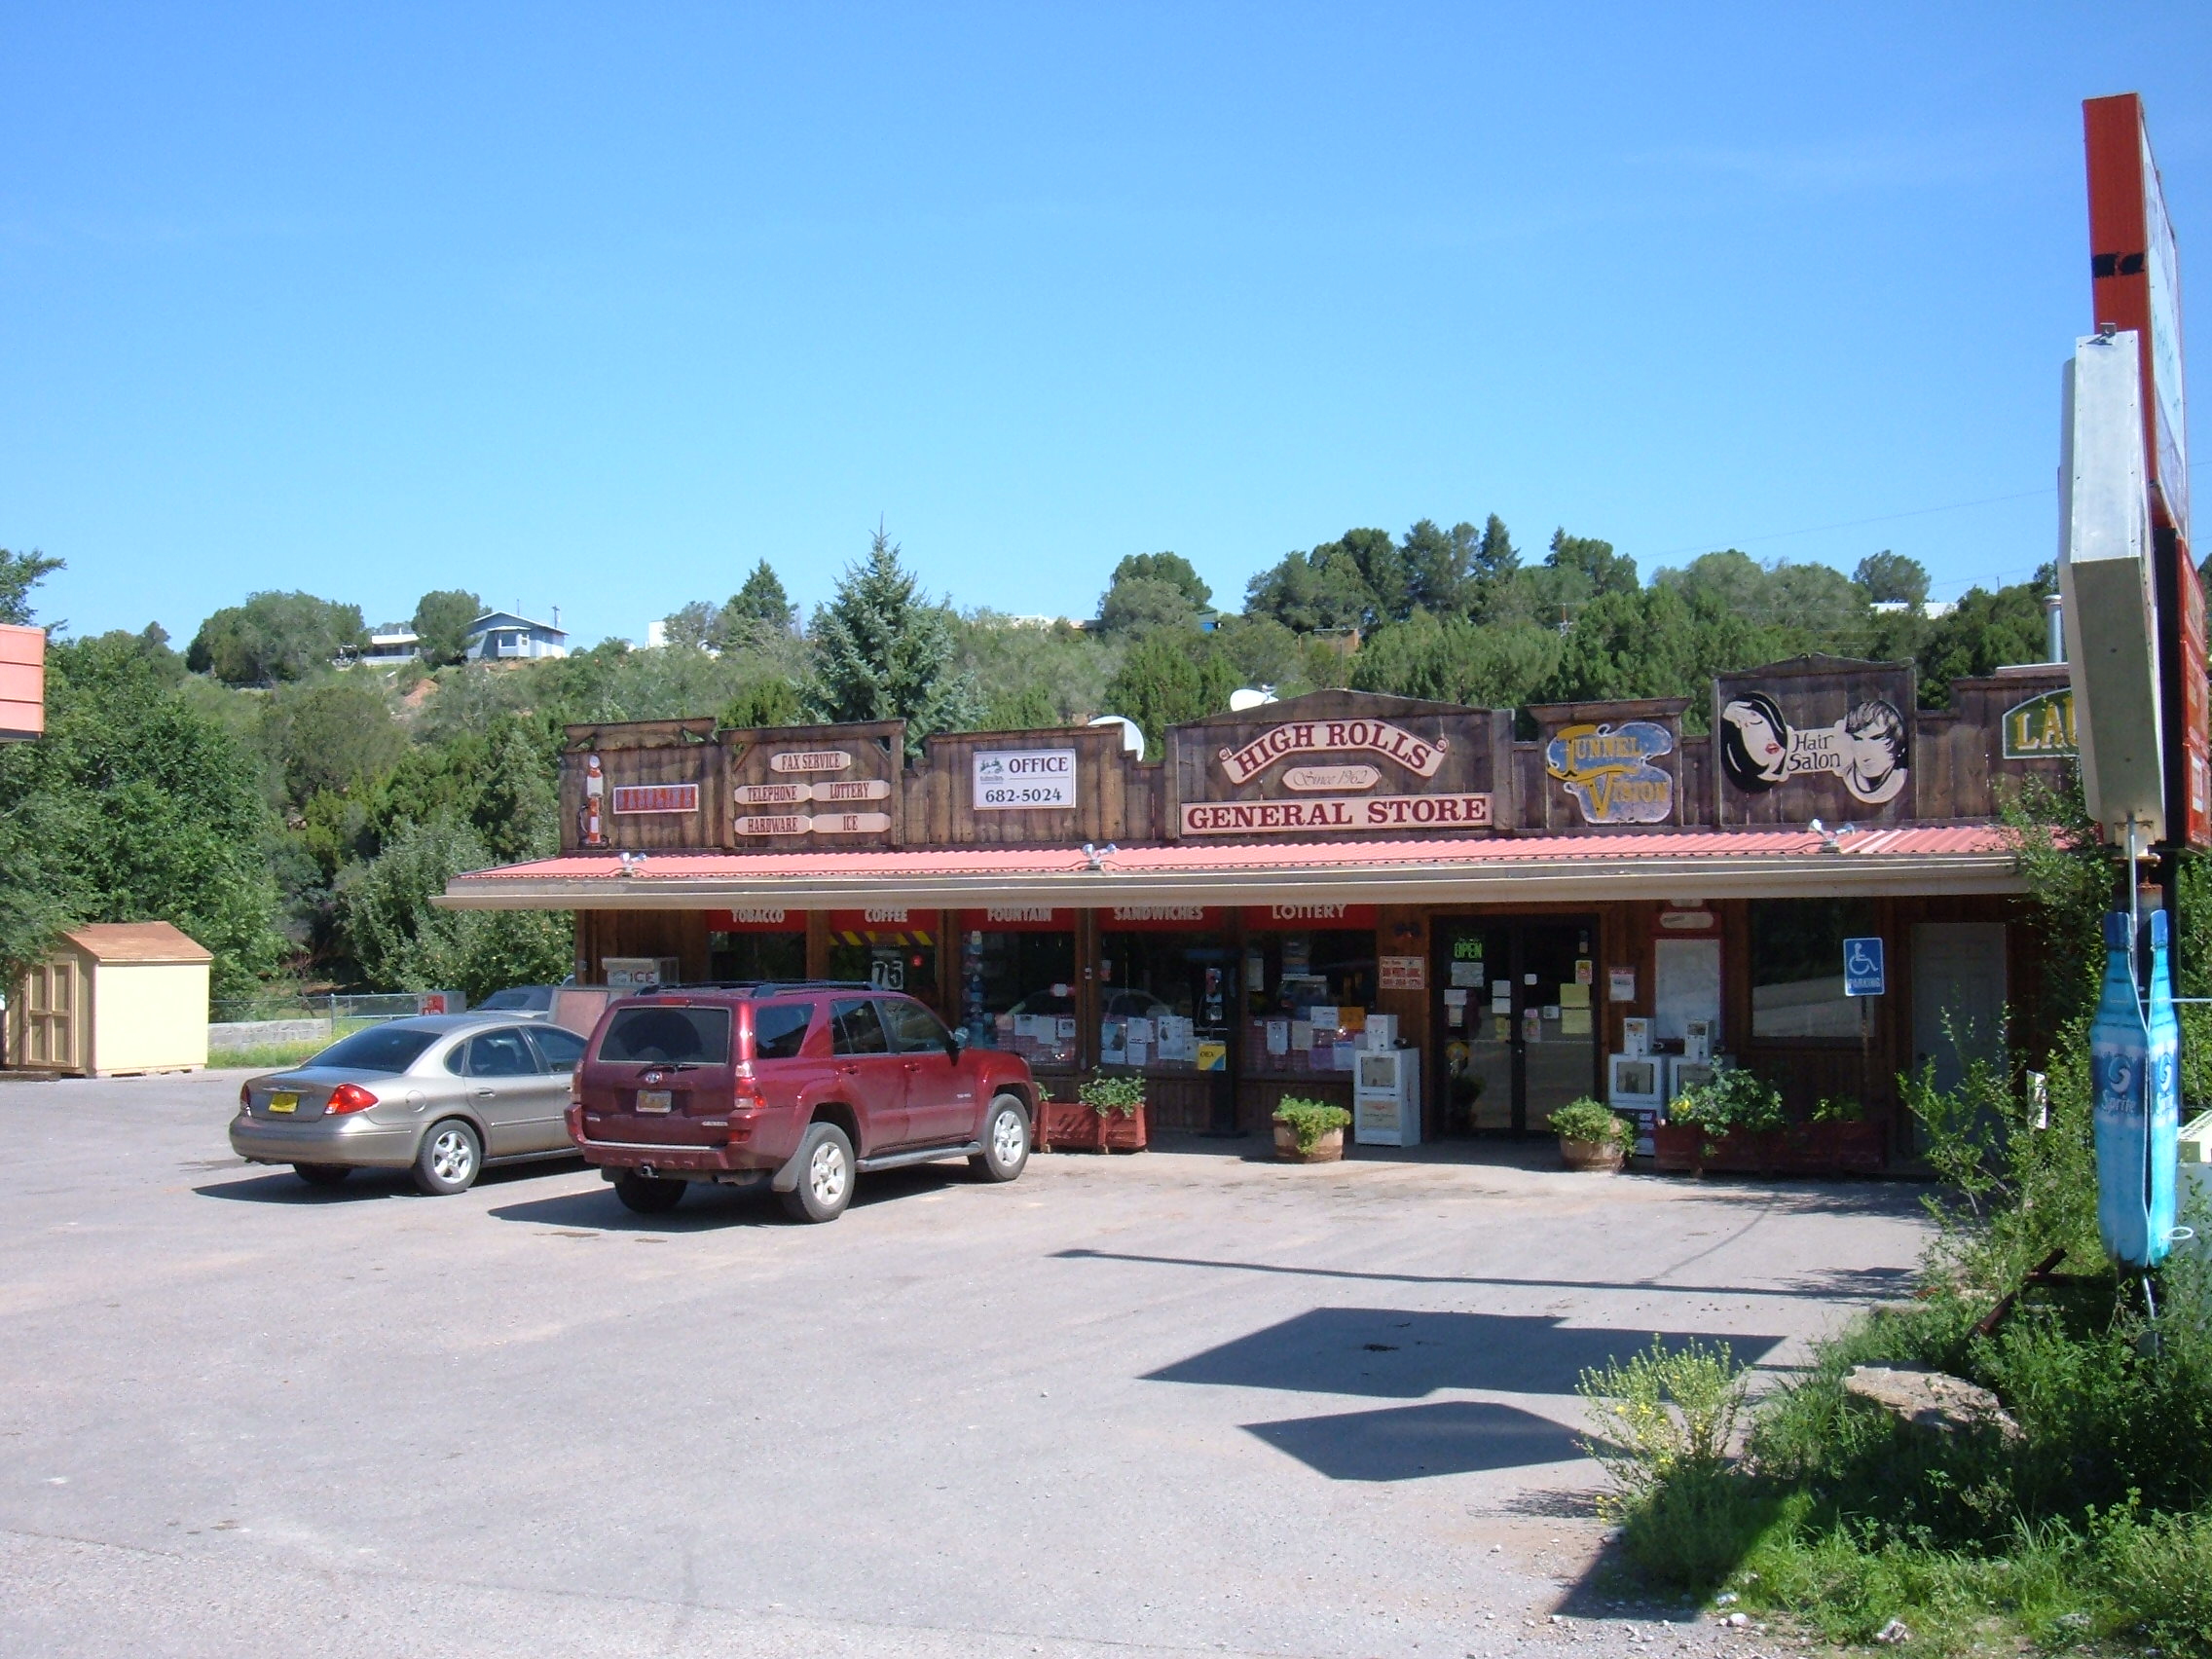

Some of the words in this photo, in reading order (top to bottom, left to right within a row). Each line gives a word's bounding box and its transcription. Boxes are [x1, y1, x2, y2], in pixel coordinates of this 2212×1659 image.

[1234, 723, 1315, 778] HIGH
[1326, 721, 1432, 770] ROLLS
[1554, 723, 1643, 776] TUNNEL
[1791, 732, 1835, 754] Hair
[782, 755, 800, 771] FAX
[802, 752, 841, 769] SERVICE
[1009, 756, 1069, 773] OFFICE
[1787, 752, 1841, 772] Salon
[747, 785, 797, 802] TELEPHONE
[829, 782, 870, 799] LOTTERY
[985, 787, 1063, 803] 682-5024
[1576, 774, 1669, 819] VISION
[1187, 802, 1353, 829] GENERAL
[1367, 797, 1487, 824] STORE
[747, 817, 798, 833] HARDWARE
[842, 815, 858, 831] ICE
[731, 908, 786, 923] TOBACCO
[865, 907, 908, 923] COFFEE
[986, 906, 1052, 923] FOUNTAIN
[1113, 905, 1203, 921] SANDWICHES
[1272, 903, 1348, 920] LOTTERY
[1454, 940, 1483, 959] OPEN
